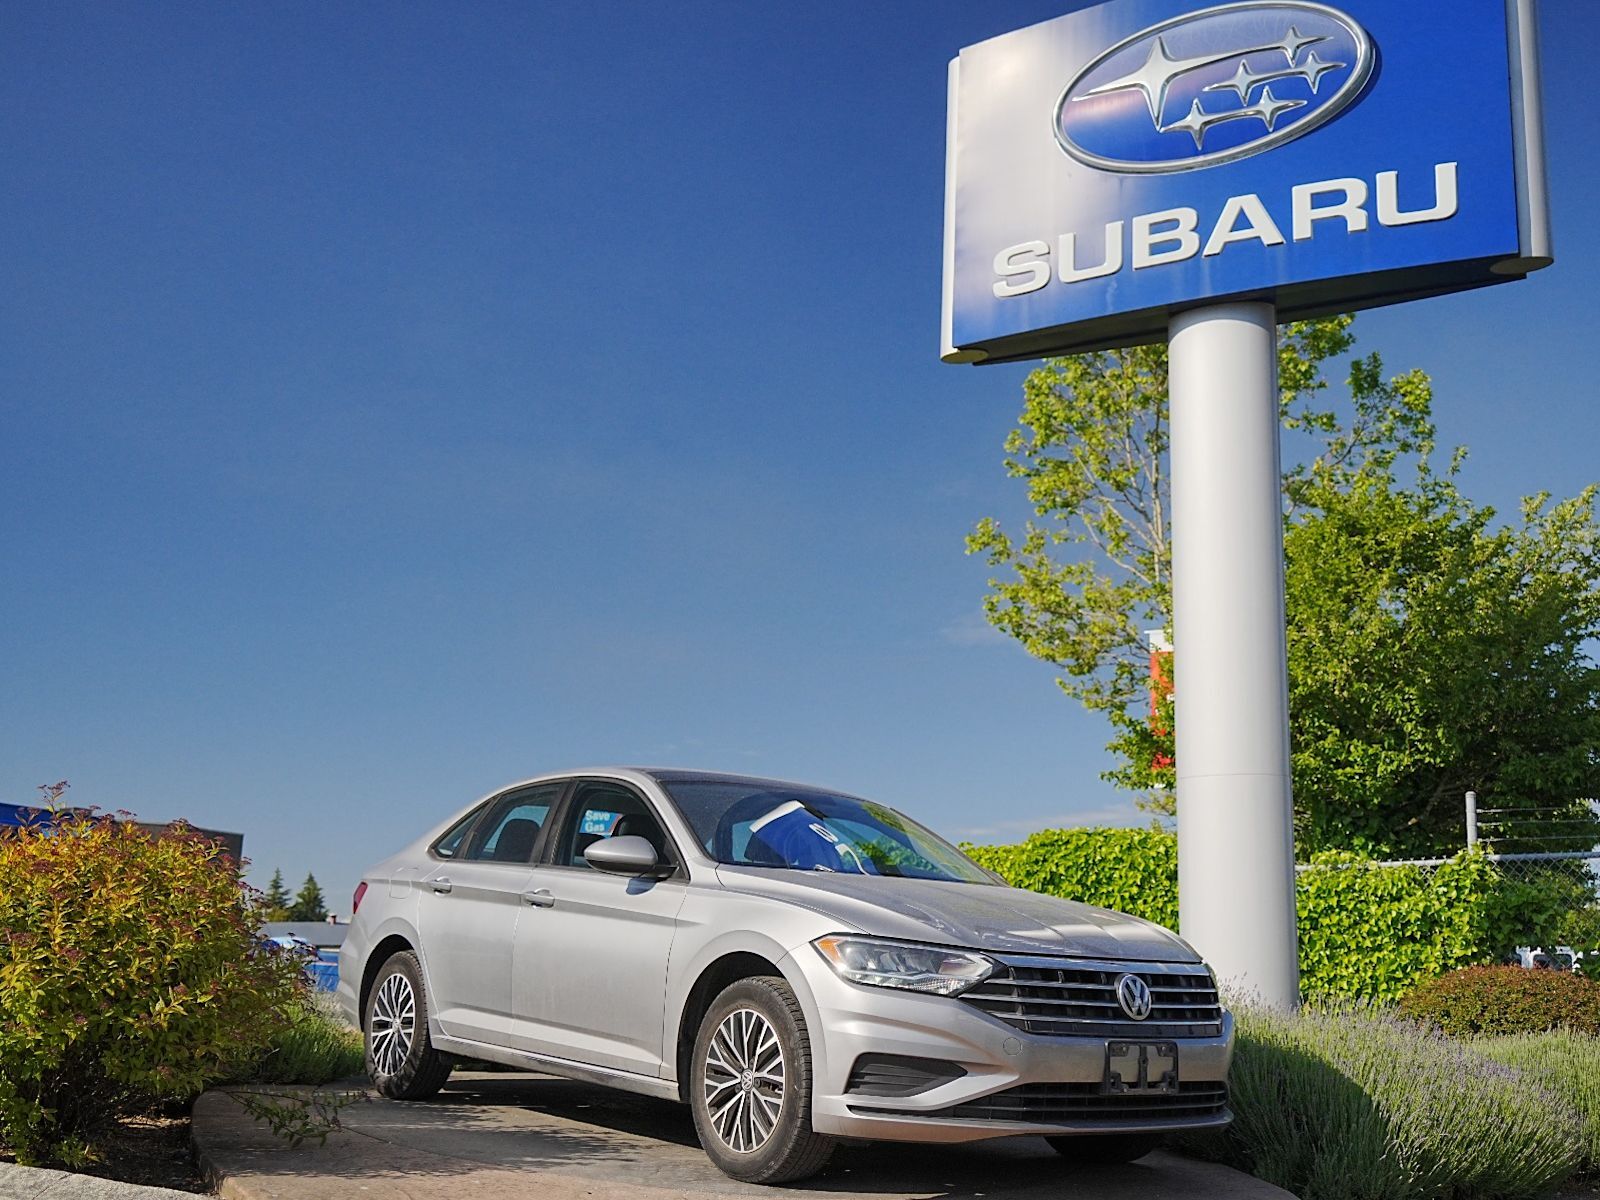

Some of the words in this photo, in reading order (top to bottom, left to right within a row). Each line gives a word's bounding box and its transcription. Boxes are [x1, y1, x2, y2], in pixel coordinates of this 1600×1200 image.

[992, 162, 1457, 299] SUBARU
[585, 810, 610, 821] Save
[585, 822, 605, 832] Gas
